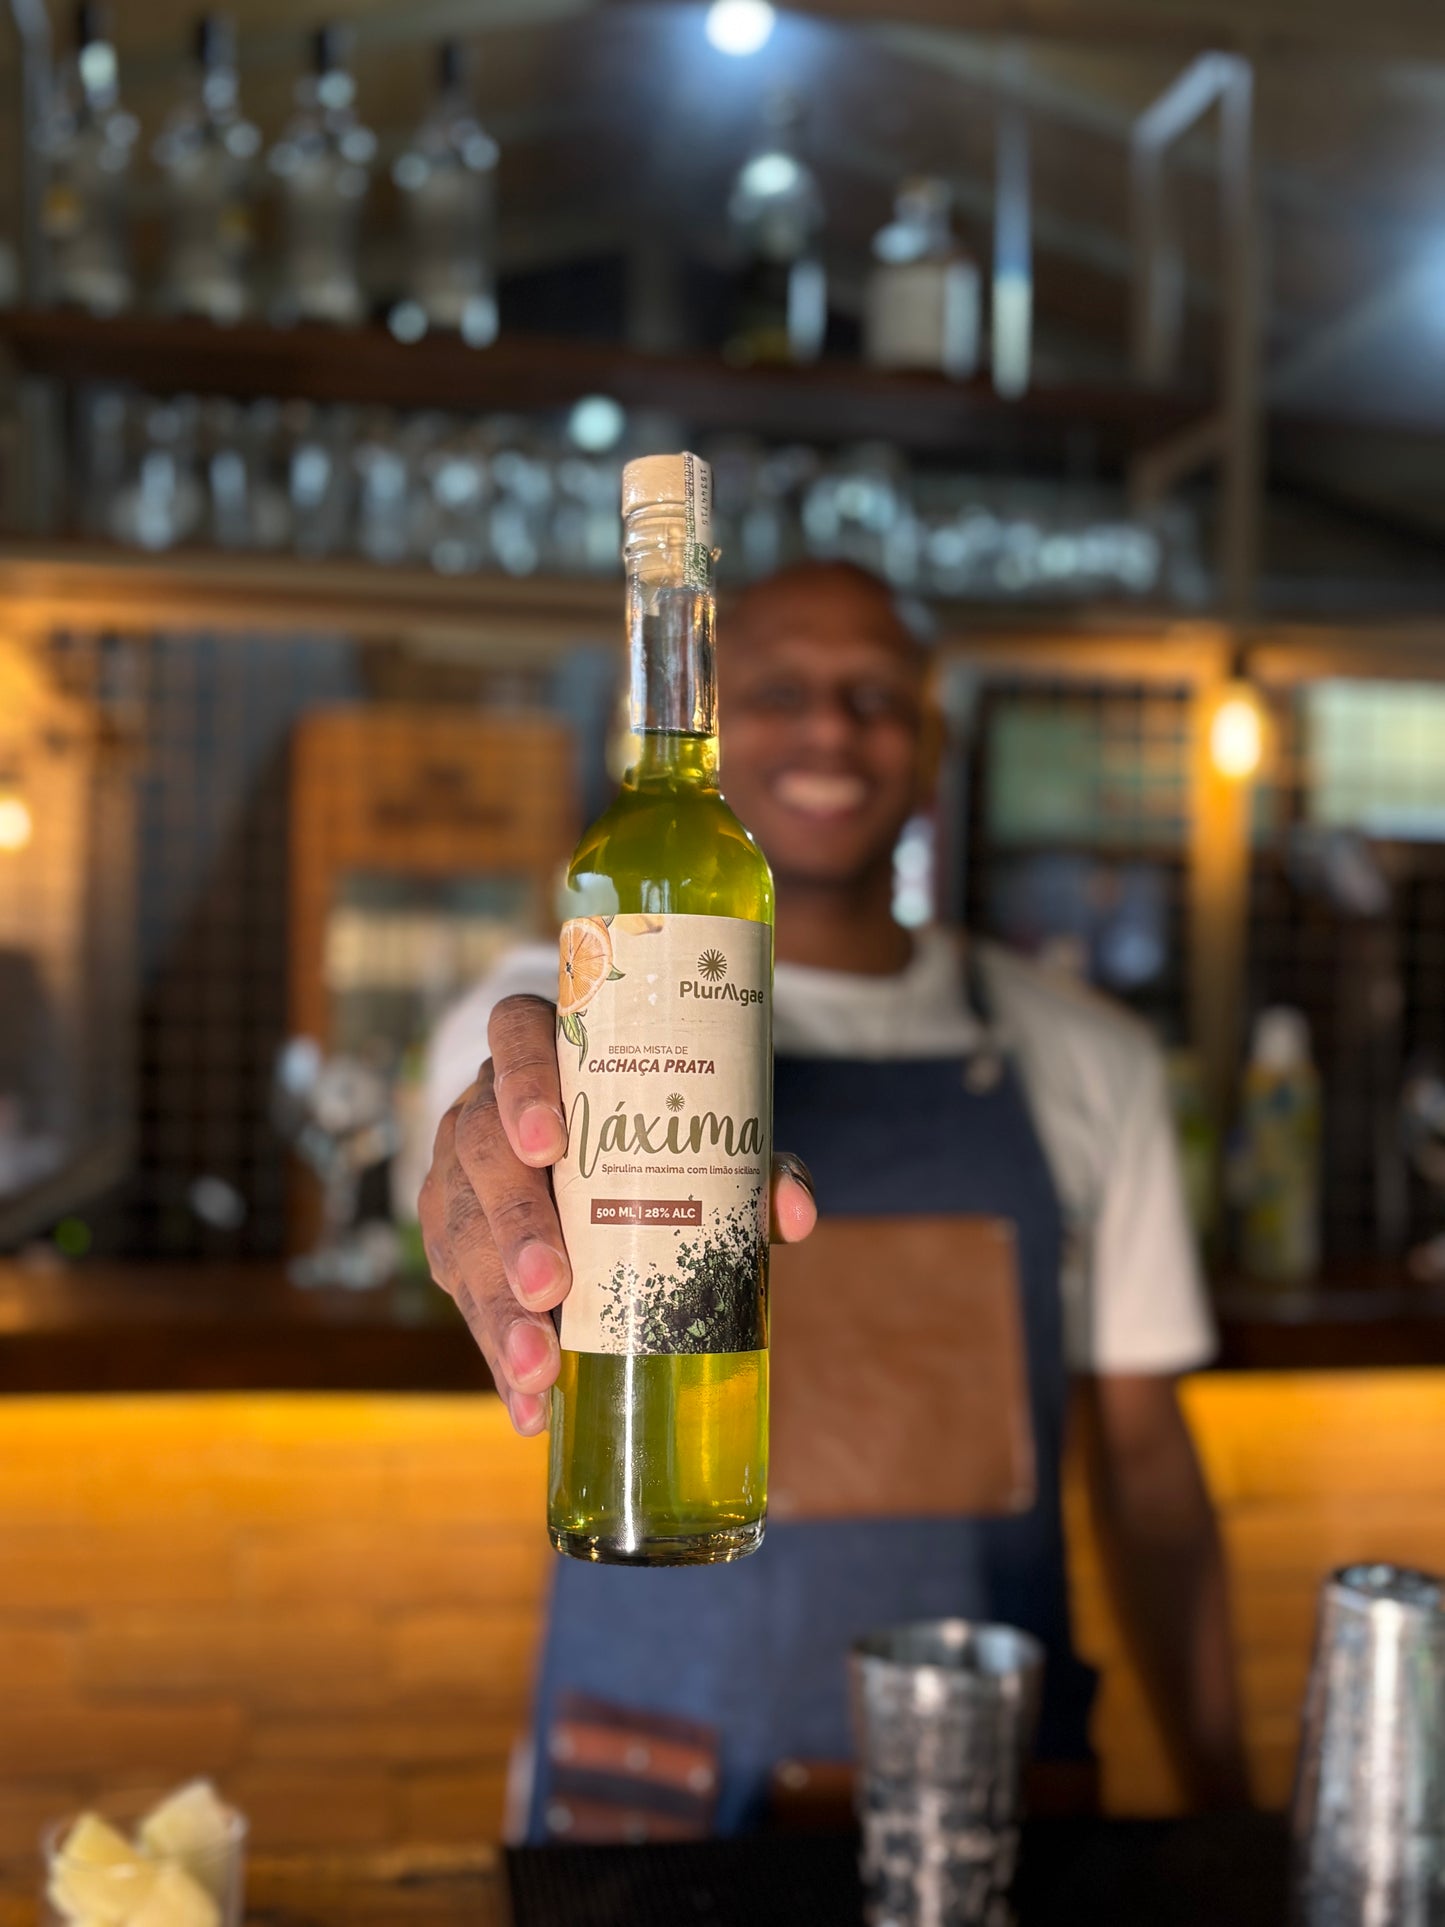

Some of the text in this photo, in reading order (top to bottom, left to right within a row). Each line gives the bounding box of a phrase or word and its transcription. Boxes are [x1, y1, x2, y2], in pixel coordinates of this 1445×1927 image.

[679, 980, 764, 1006] PlurAlgae
[608, 1045, 689, 1055] BEBIDA MISTA DE
[588, 1059, 715, 1076] CACHAÇA PRATA
[601, 1163, 761, 1175] Spirulina maxima com limão siciliano
[596, 1207, 616, 1219] 500
[618, 1207, 636, 1218] ML
[644, 1207, 670, 1218] 28%
[672, 1207, 696, 1218] ALC
